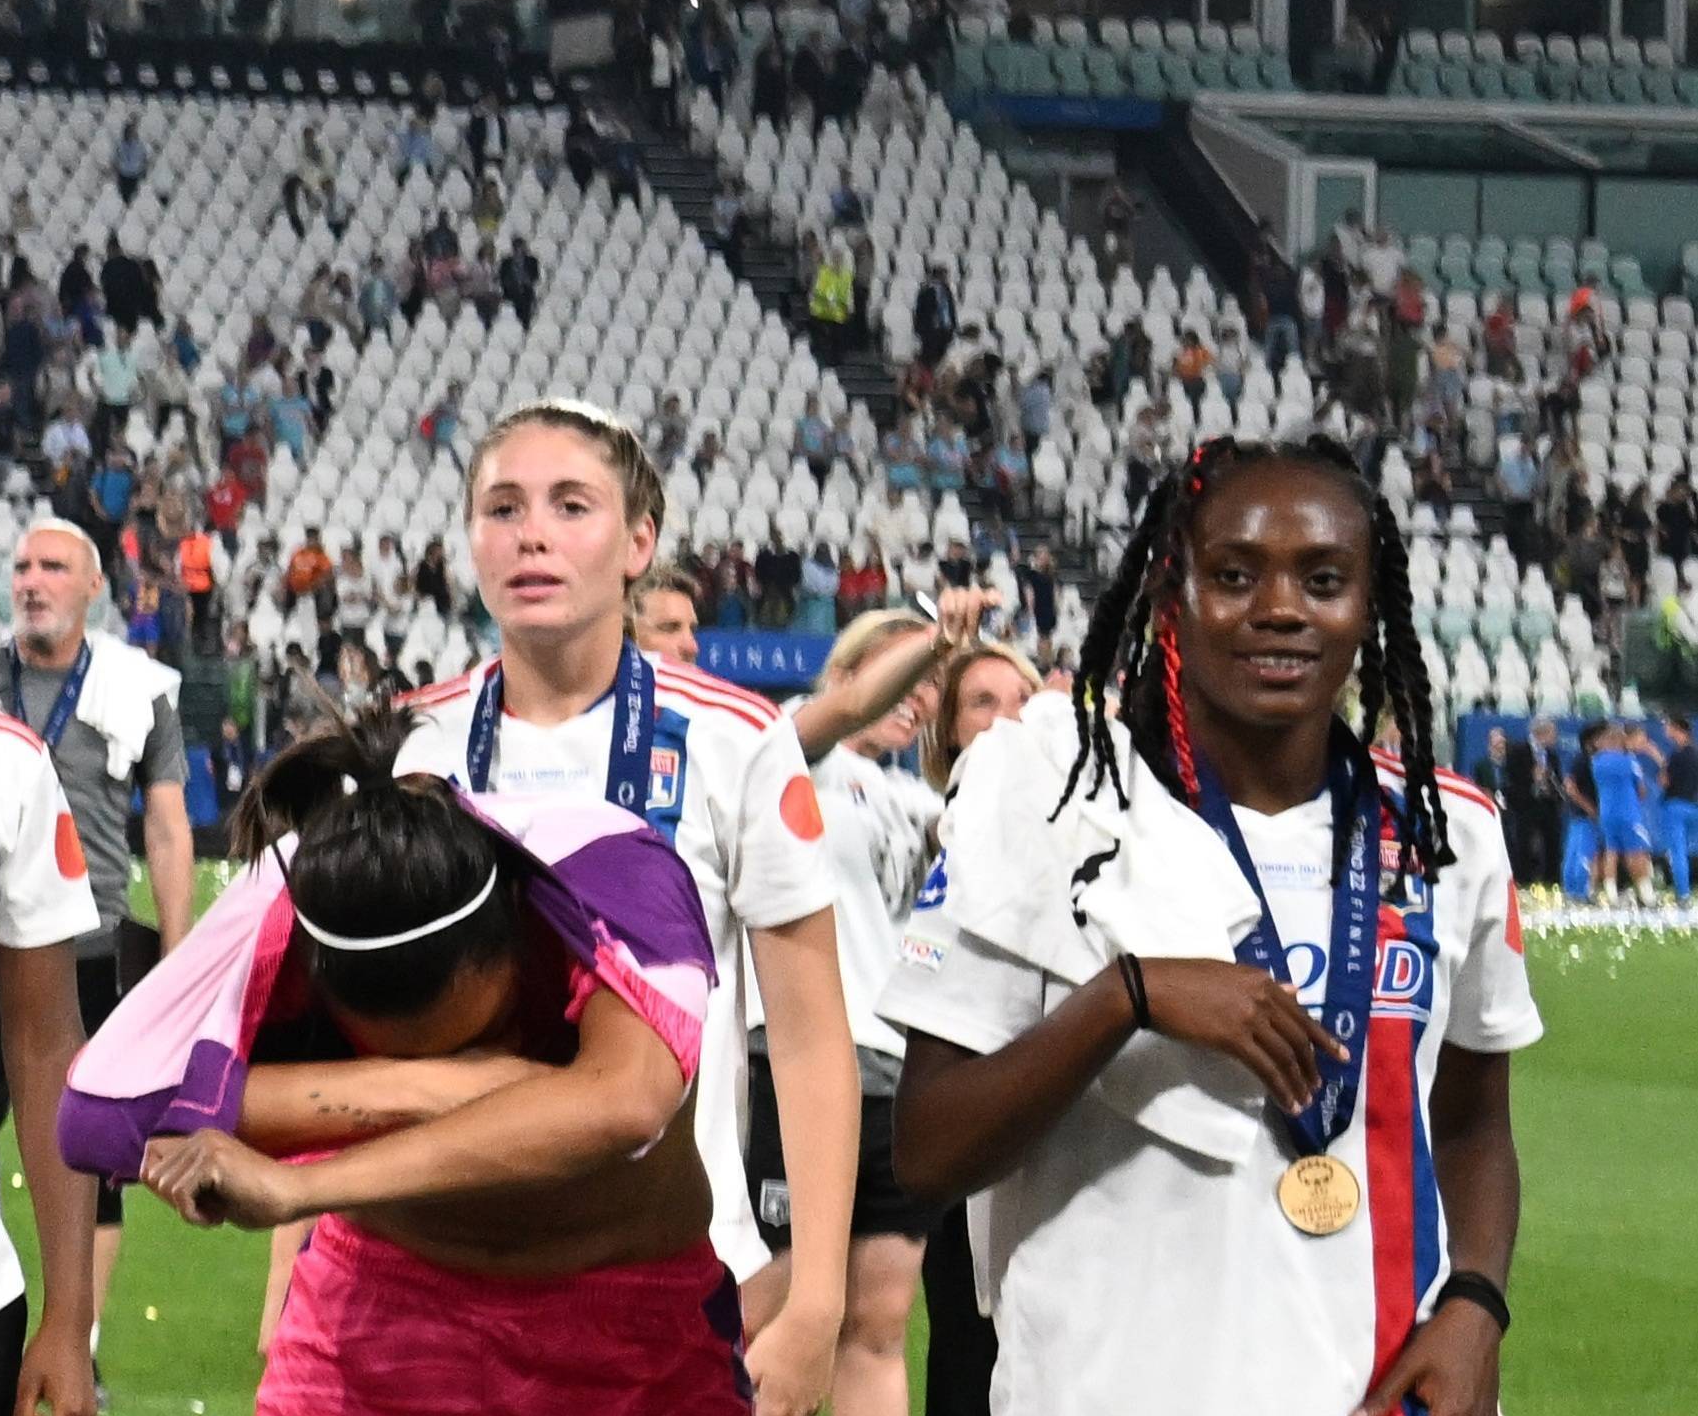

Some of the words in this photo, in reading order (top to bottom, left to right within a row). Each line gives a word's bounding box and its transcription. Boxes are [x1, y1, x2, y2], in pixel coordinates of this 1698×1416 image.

[708, 642, 807, 672] FINAL
[1348, 870, 1366, 893] 22
[1347, 897, 1364, 975] FINAL
